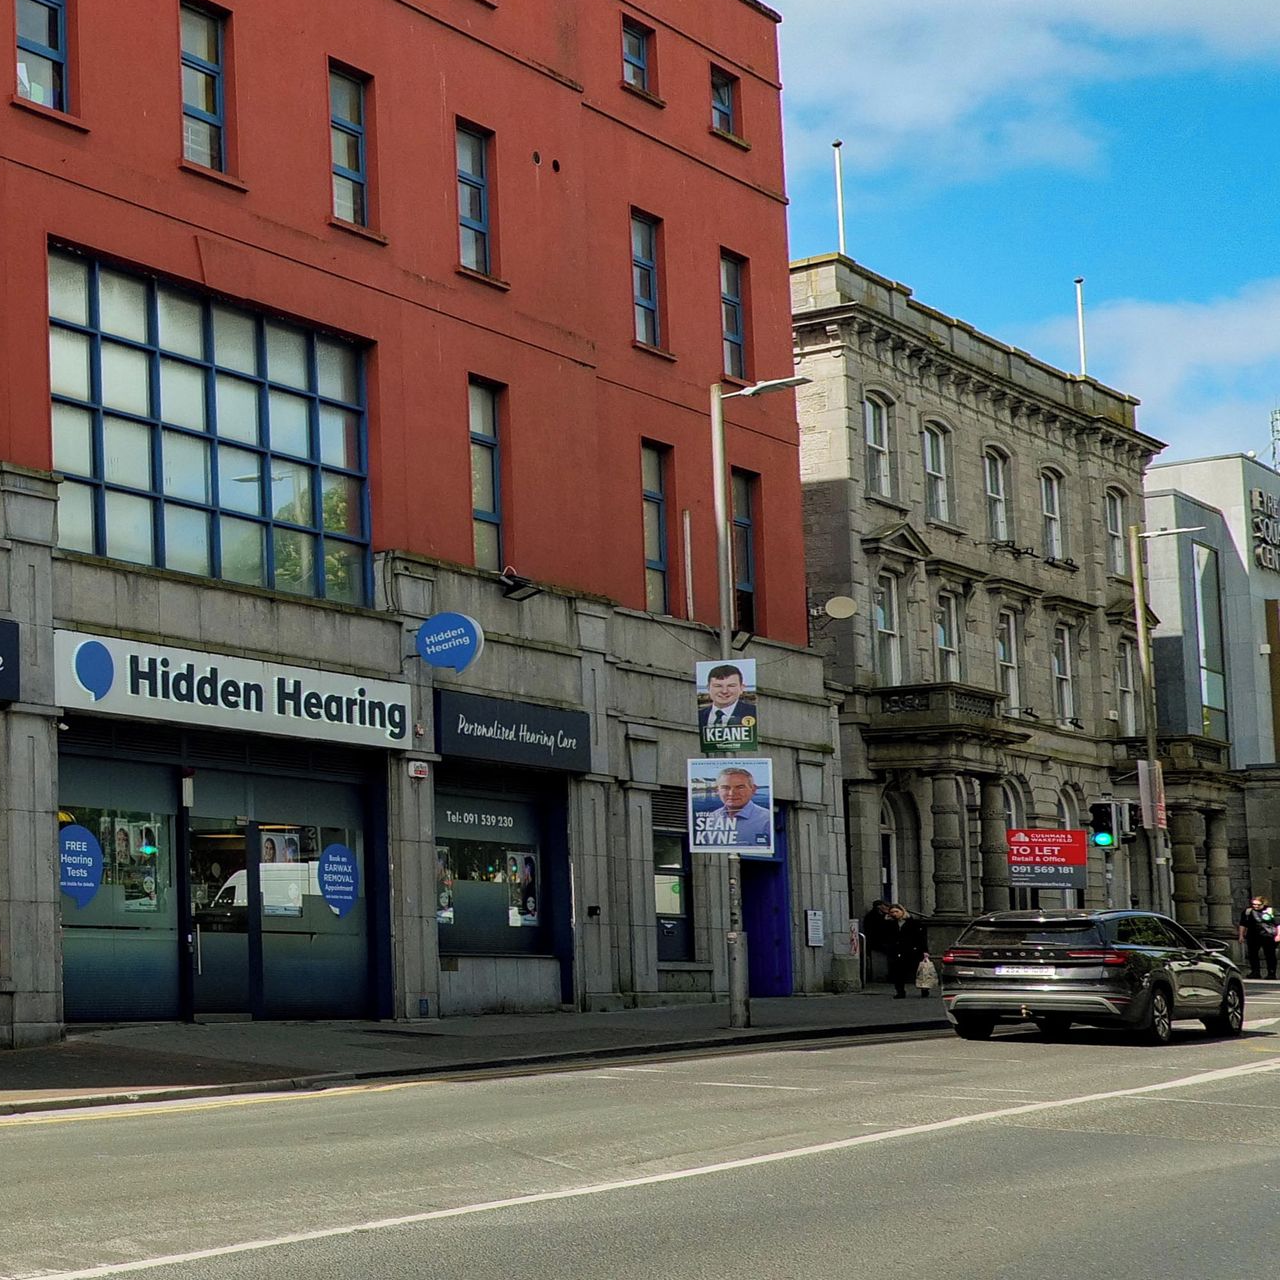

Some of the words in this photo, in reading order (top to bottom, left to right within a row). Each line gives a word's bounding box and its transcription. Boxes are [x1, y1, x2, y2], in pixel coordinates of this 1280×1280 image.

[425, 627, 465, 645] Hidden
[426, 636, 470, 655] Hearing
[128, 654, 264, 713] Hidden
[276, 676, 407, 740] Hearing
[457, 713, 517, 742] Personalised
[519, 724, 555, 756] Hearing
[557, 730, 577, 750] Care
[706, 727, 750, 741] KEANE
[446, 811, 462, 823] Tel:
[463, 813, 478, 824] 091
[481, 814, 496, 826] 539
[497, 816, 513, 827] 230
[695, 831, 739, 844] KYNE
[65, 840, 88, 851] FREE
[1010, 846, 1030, 855] TO
[1035, 846, 1061, 855] LET
[60, 854, 93, 867] Hearing
[66, 867, 88, 877] Tests
[325, 864, 352, 872] EARWAX
[323, 874, 354, 883] REMOVAL
